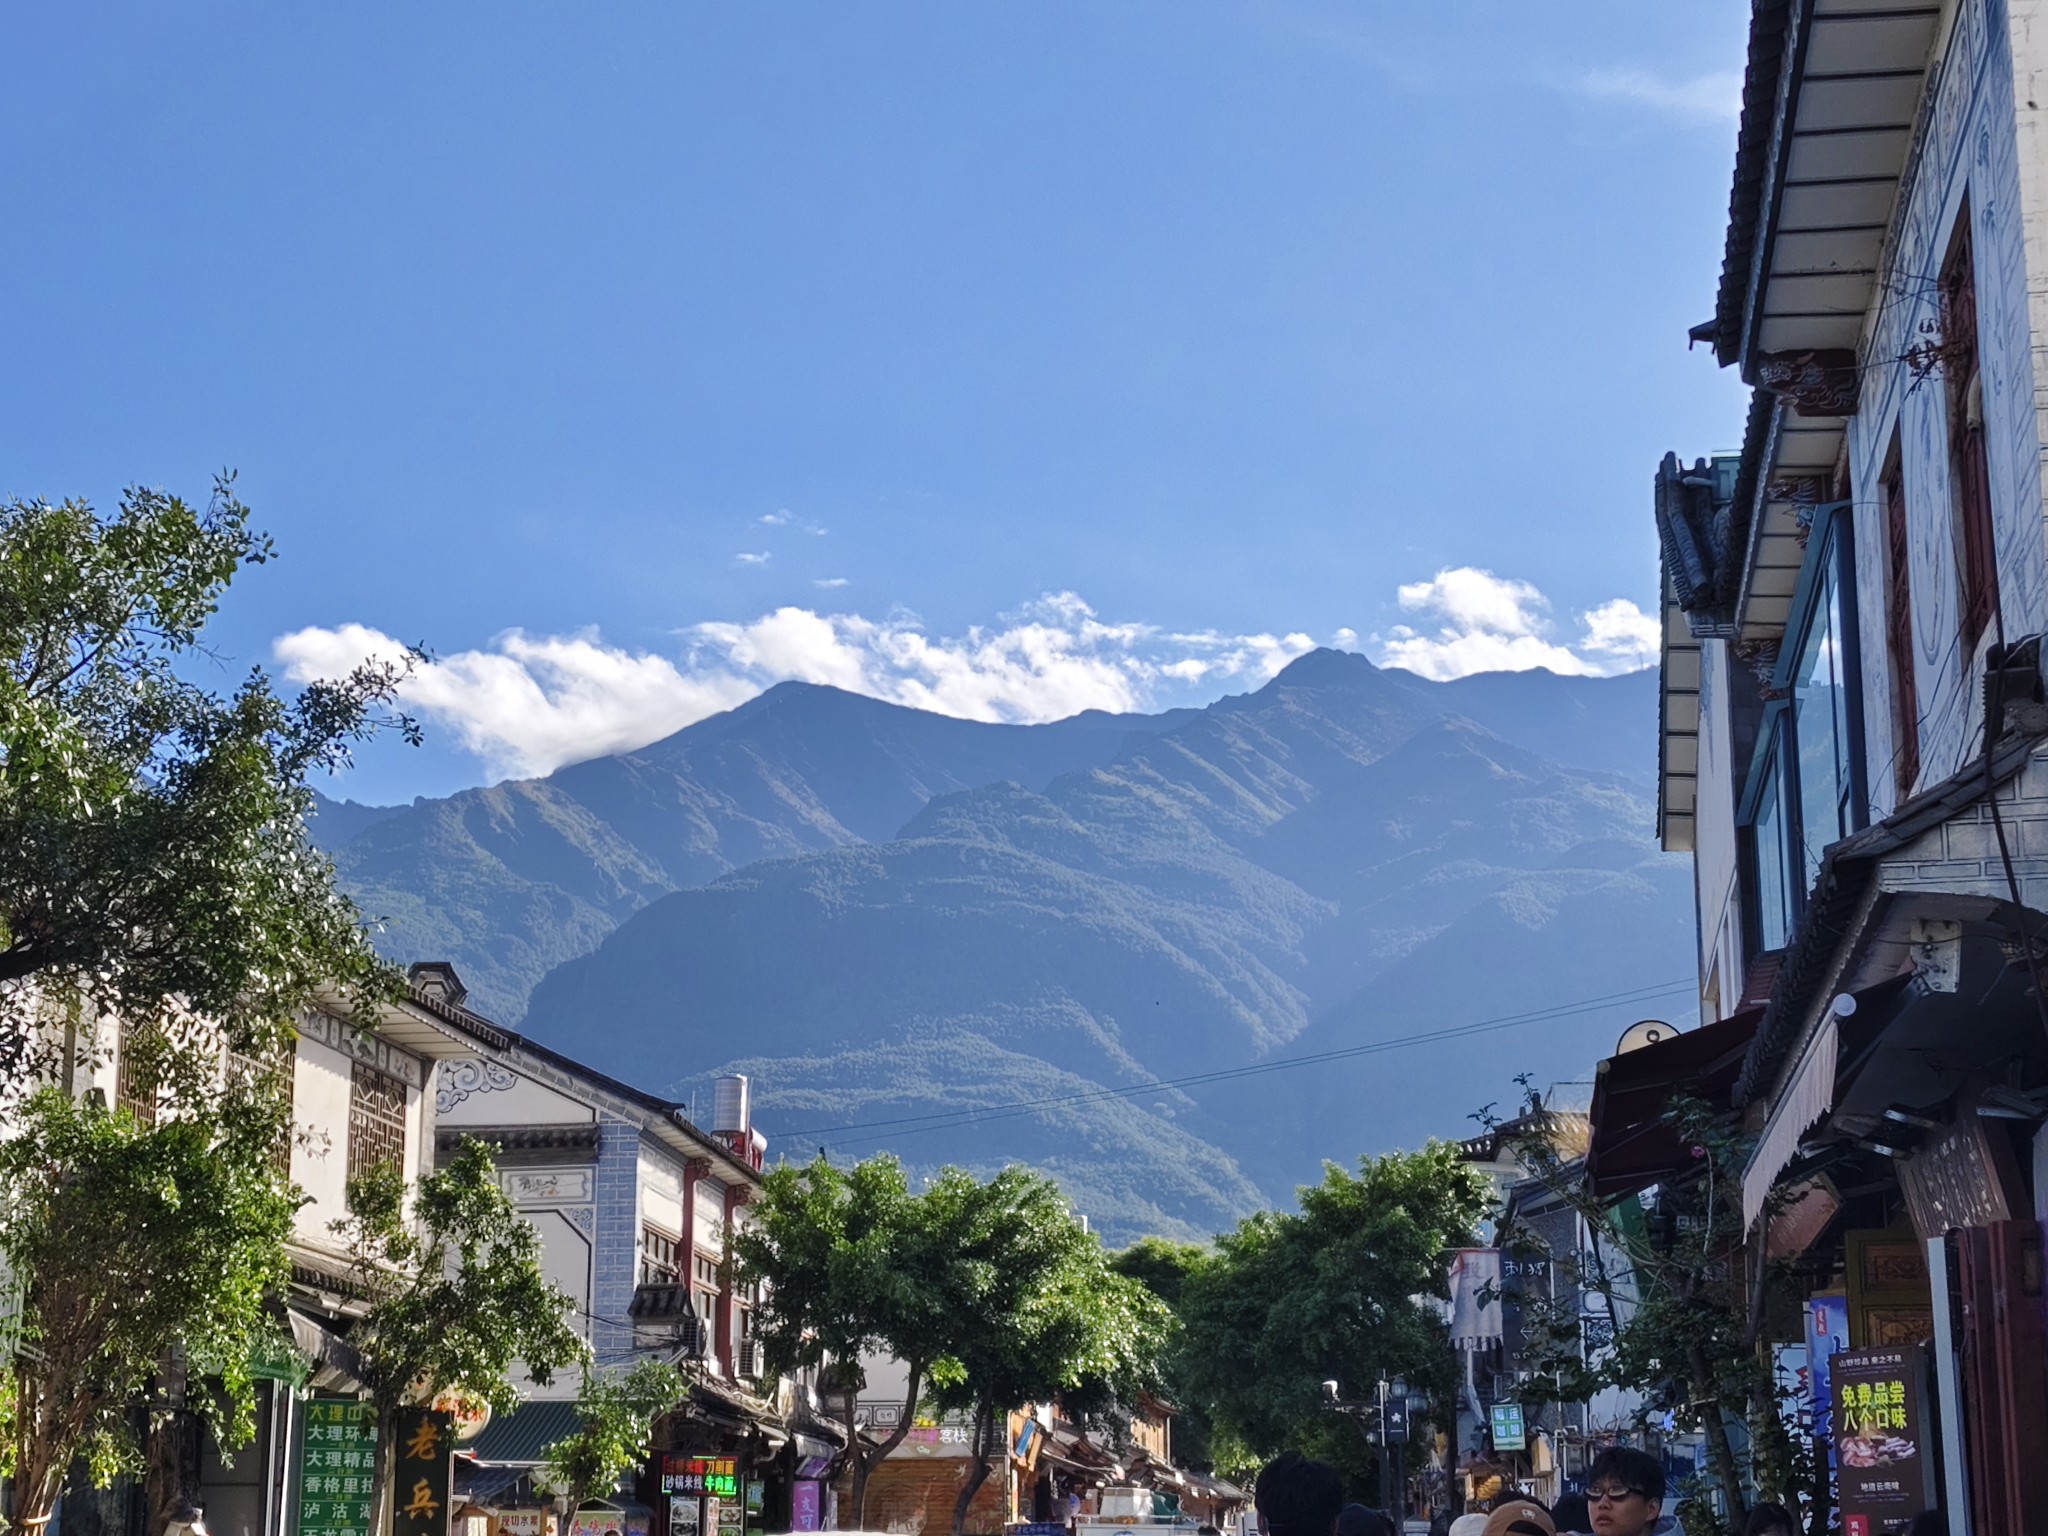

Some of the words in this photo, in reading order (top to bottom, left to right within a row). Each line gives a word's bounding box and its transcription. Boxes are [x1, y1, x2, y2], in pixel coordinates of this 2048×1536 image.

[1841, 1380, 1905, 1408] 免费品尝
[1843, 1405, 1908, 1431] 八个口味
[939, 1427, 969, 1444] 客栈
[306, 1450, 375, 1468] 大理精品
[403, 1414, 441, 1521] 老兵
[706, 1459, 735, 1475] 刀削面
[304, 1476, 373, 1494] 香格里拉
[665, 1474, 703, 1491] 砂锅米线
[705, 1475, 735, 1492] 牛肉面
[303, 1502, 372, 1519] 泸沽湖
